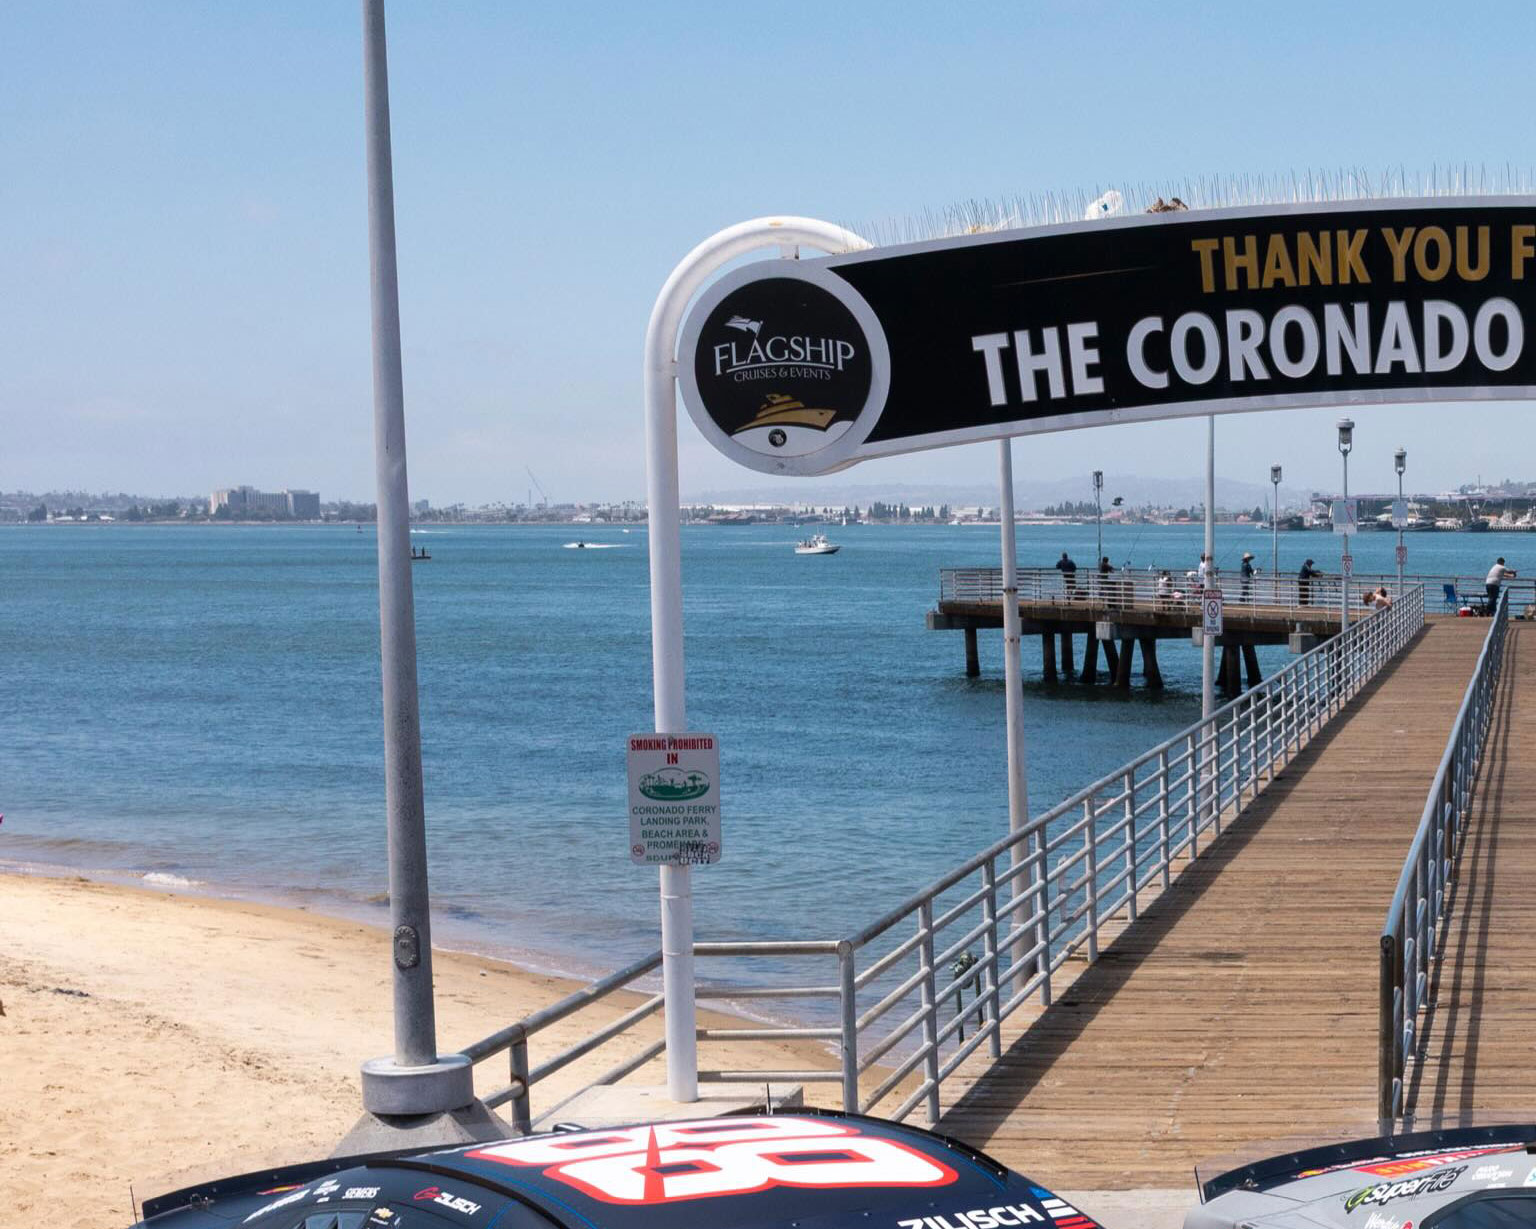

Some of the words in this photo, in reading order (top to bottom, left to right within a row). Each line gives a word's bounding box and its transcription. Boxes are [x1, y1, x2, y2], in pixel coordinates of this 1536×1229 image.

[1192, 228, 1373, 293] THANK
[1382, 225, 1491, 282] YOU
[713, 336, 855, 376] FLAGSHIP
[971, 320, 1104, 407] THE
[1125, 296, 1525, 390] CORONADO
[734, 367, 777, 382] CRUISES
[778, 367, 789, 378] &
[790, 367, 832, 381] EVENTS
[631, 739, 666, 751] SMOKING
[668, 738, 713, 750] PROHIBITED
[666, 753, 679, 765] IN
[632, 806, 685, 815] CORONADO
[687, 805, 716, 814] FERRY
[640, 817, 680, 826] LANDING
[642, 830, 673, 838] BEACH
[676, 829, 700, 838] AREA
[702, 829, 709, 838] &
[465, 1117, 960, 1204] 88
